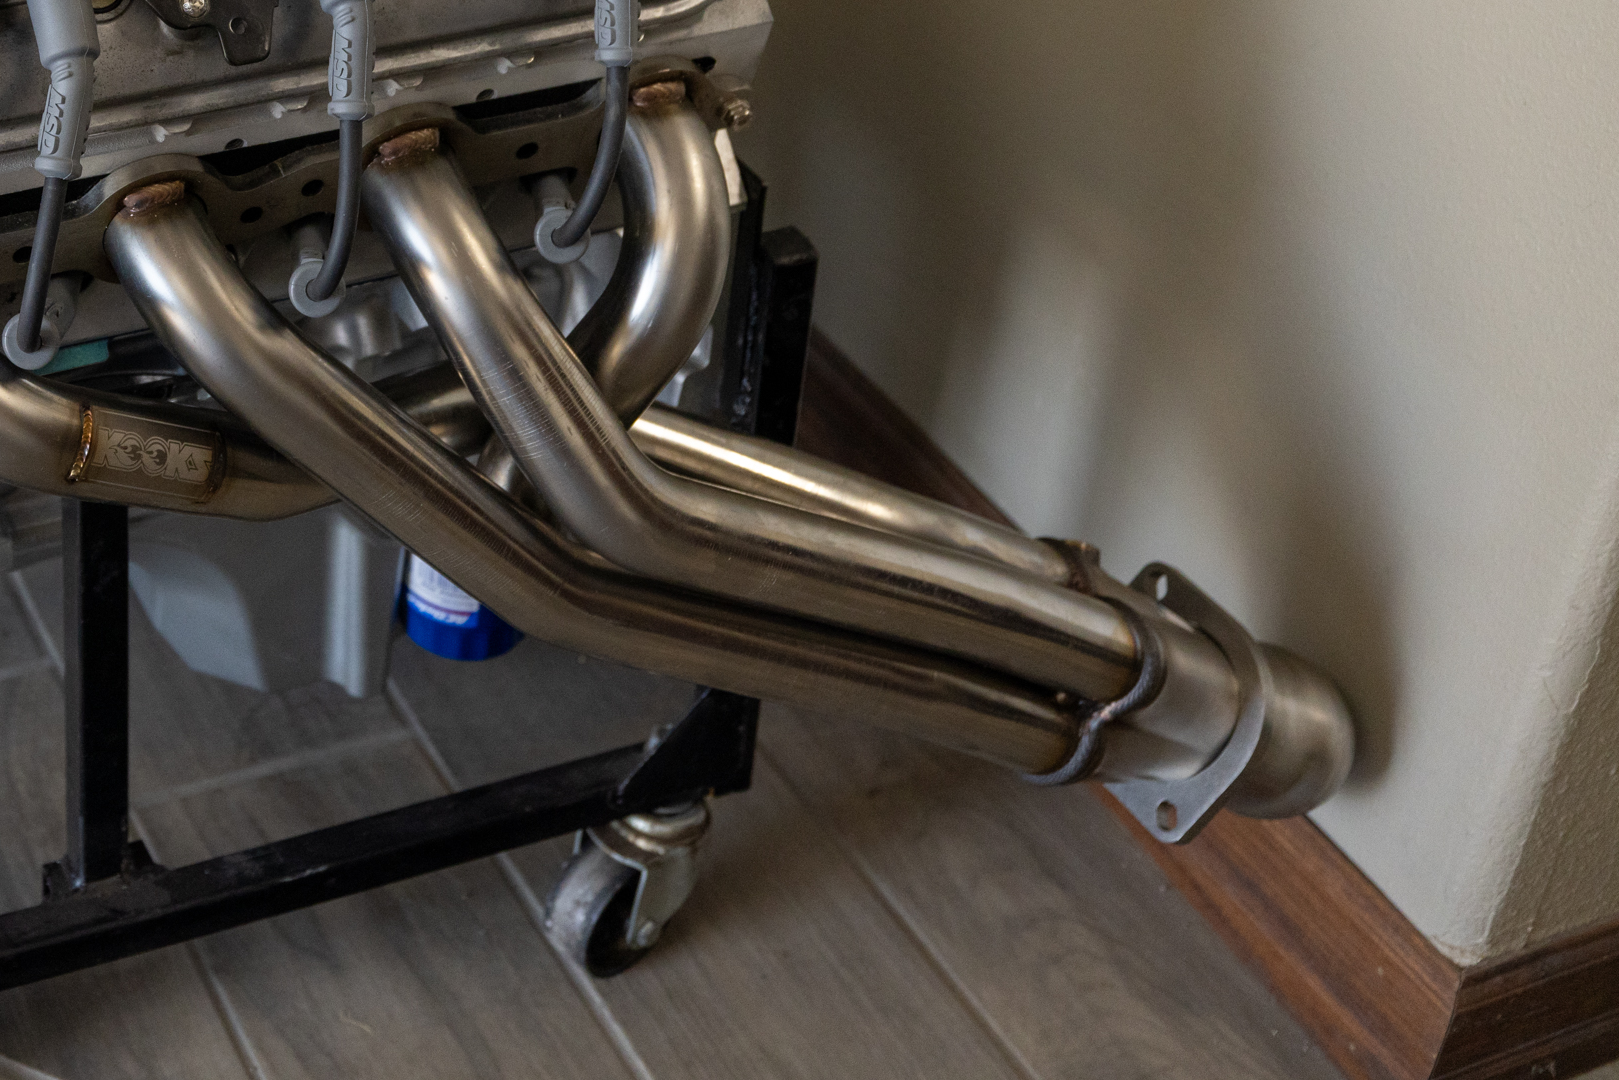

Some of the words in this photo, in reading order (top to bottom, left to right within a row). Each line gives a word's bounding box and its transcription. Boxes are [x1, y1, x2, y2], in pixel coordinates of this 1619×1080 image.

[332, 31, 353, 99] MSD
[41, 85, 66, 156] MSD
[91, 426, 214, 485] KOOKS
